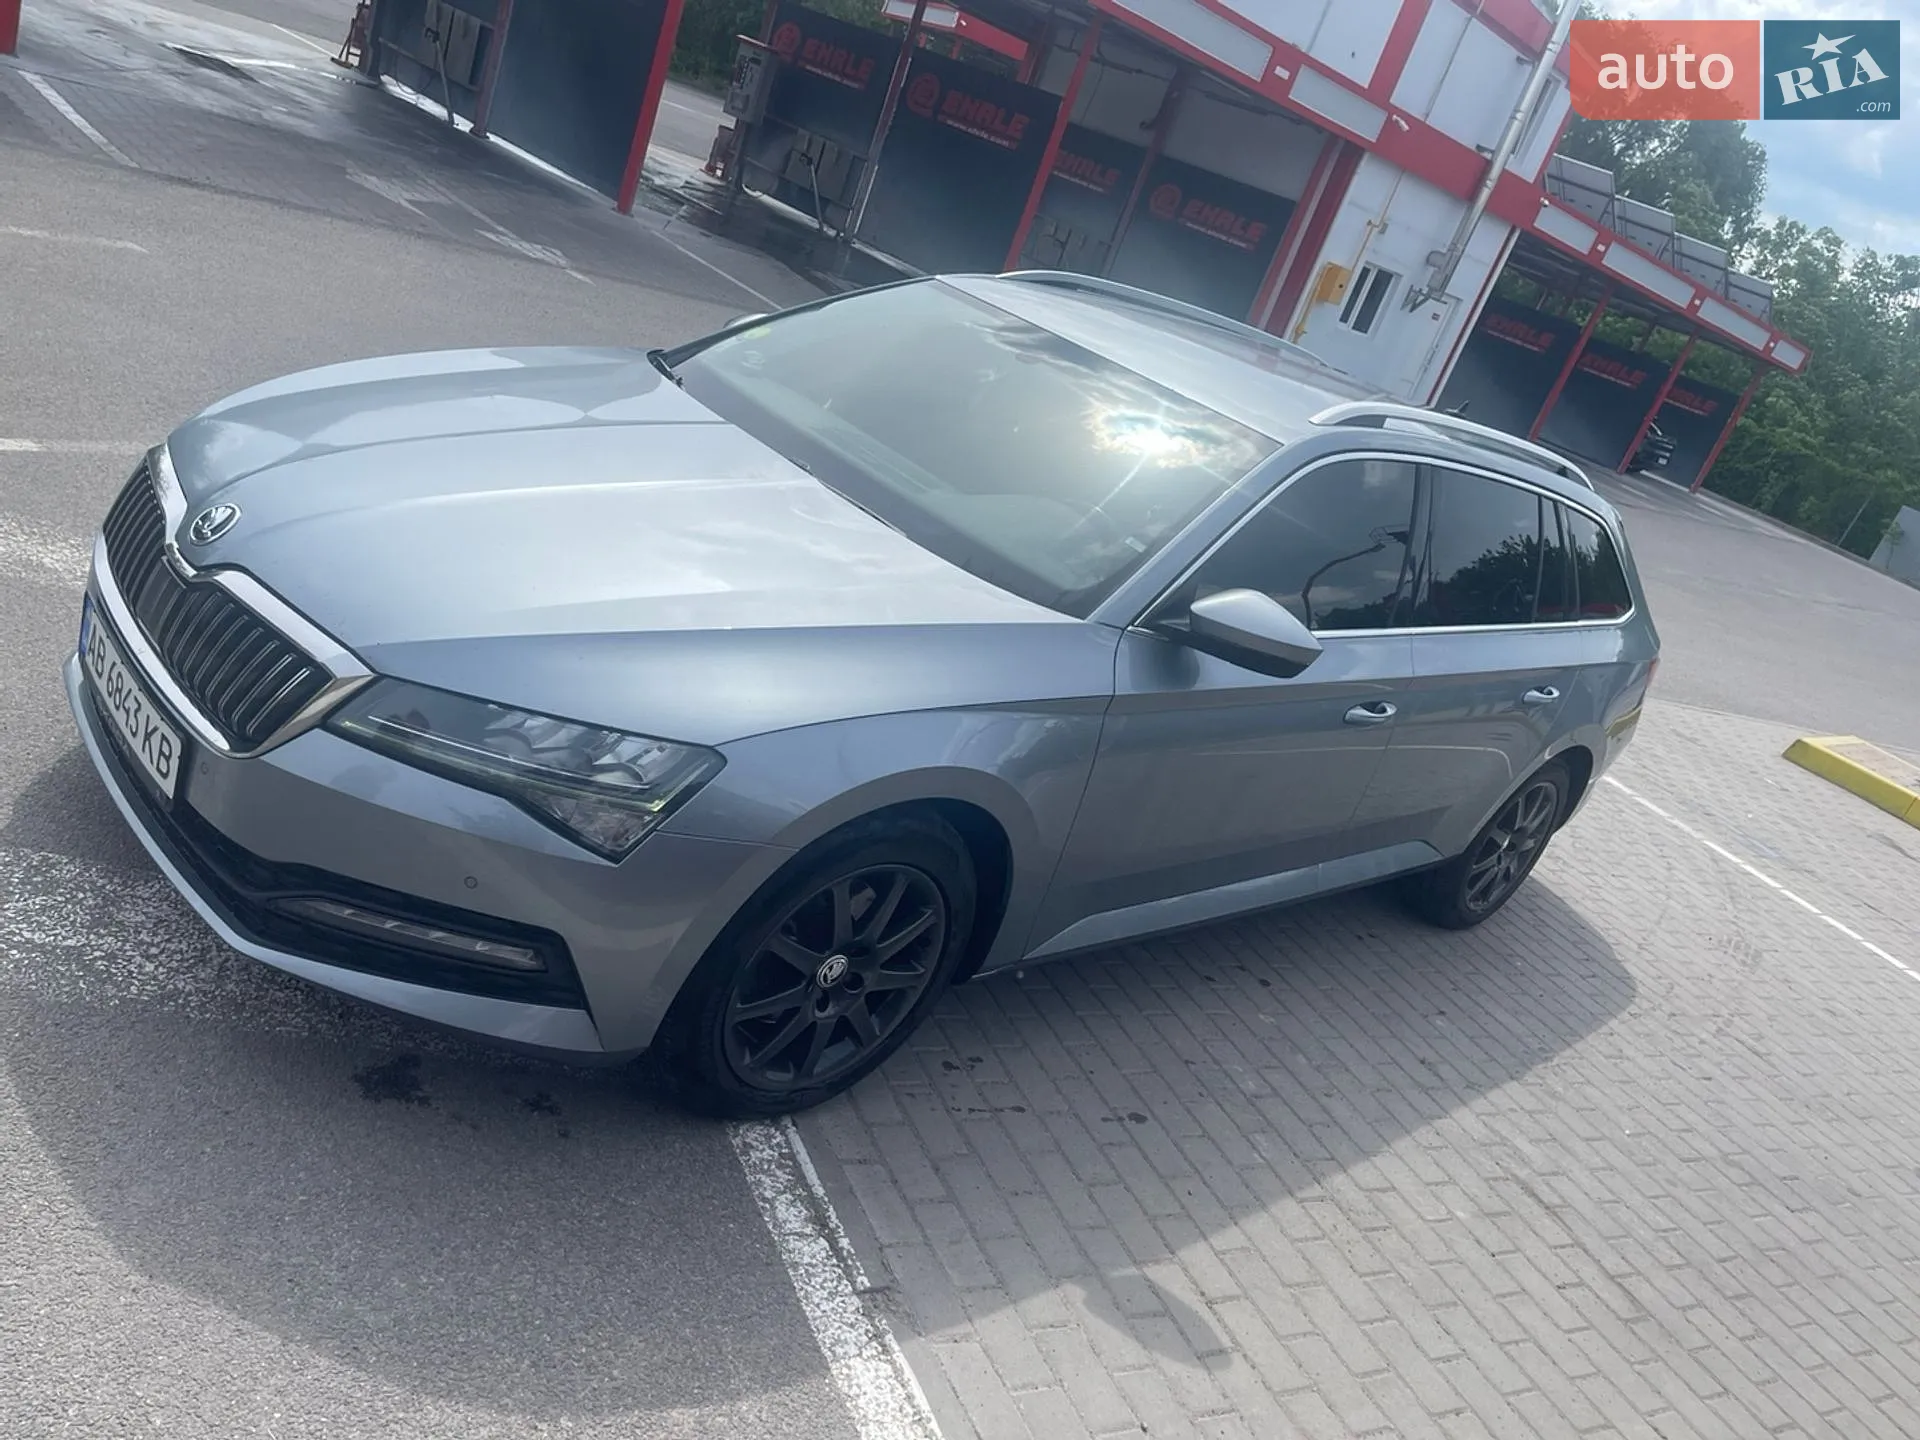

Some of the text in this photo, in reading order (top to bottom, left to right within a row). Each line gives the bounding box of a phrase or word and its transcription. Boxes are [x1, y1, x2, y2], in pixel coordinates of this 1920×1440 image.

[802, 38, 875, 80] EHRLE
[941, 89, 1030, 139] EHRLE
[1182, 198, 1267, 243] EHRLE
[87, 623, 106, 680] AB
[106, 660, 142, 739] 6843
[141, 713, 173, 781] KB
